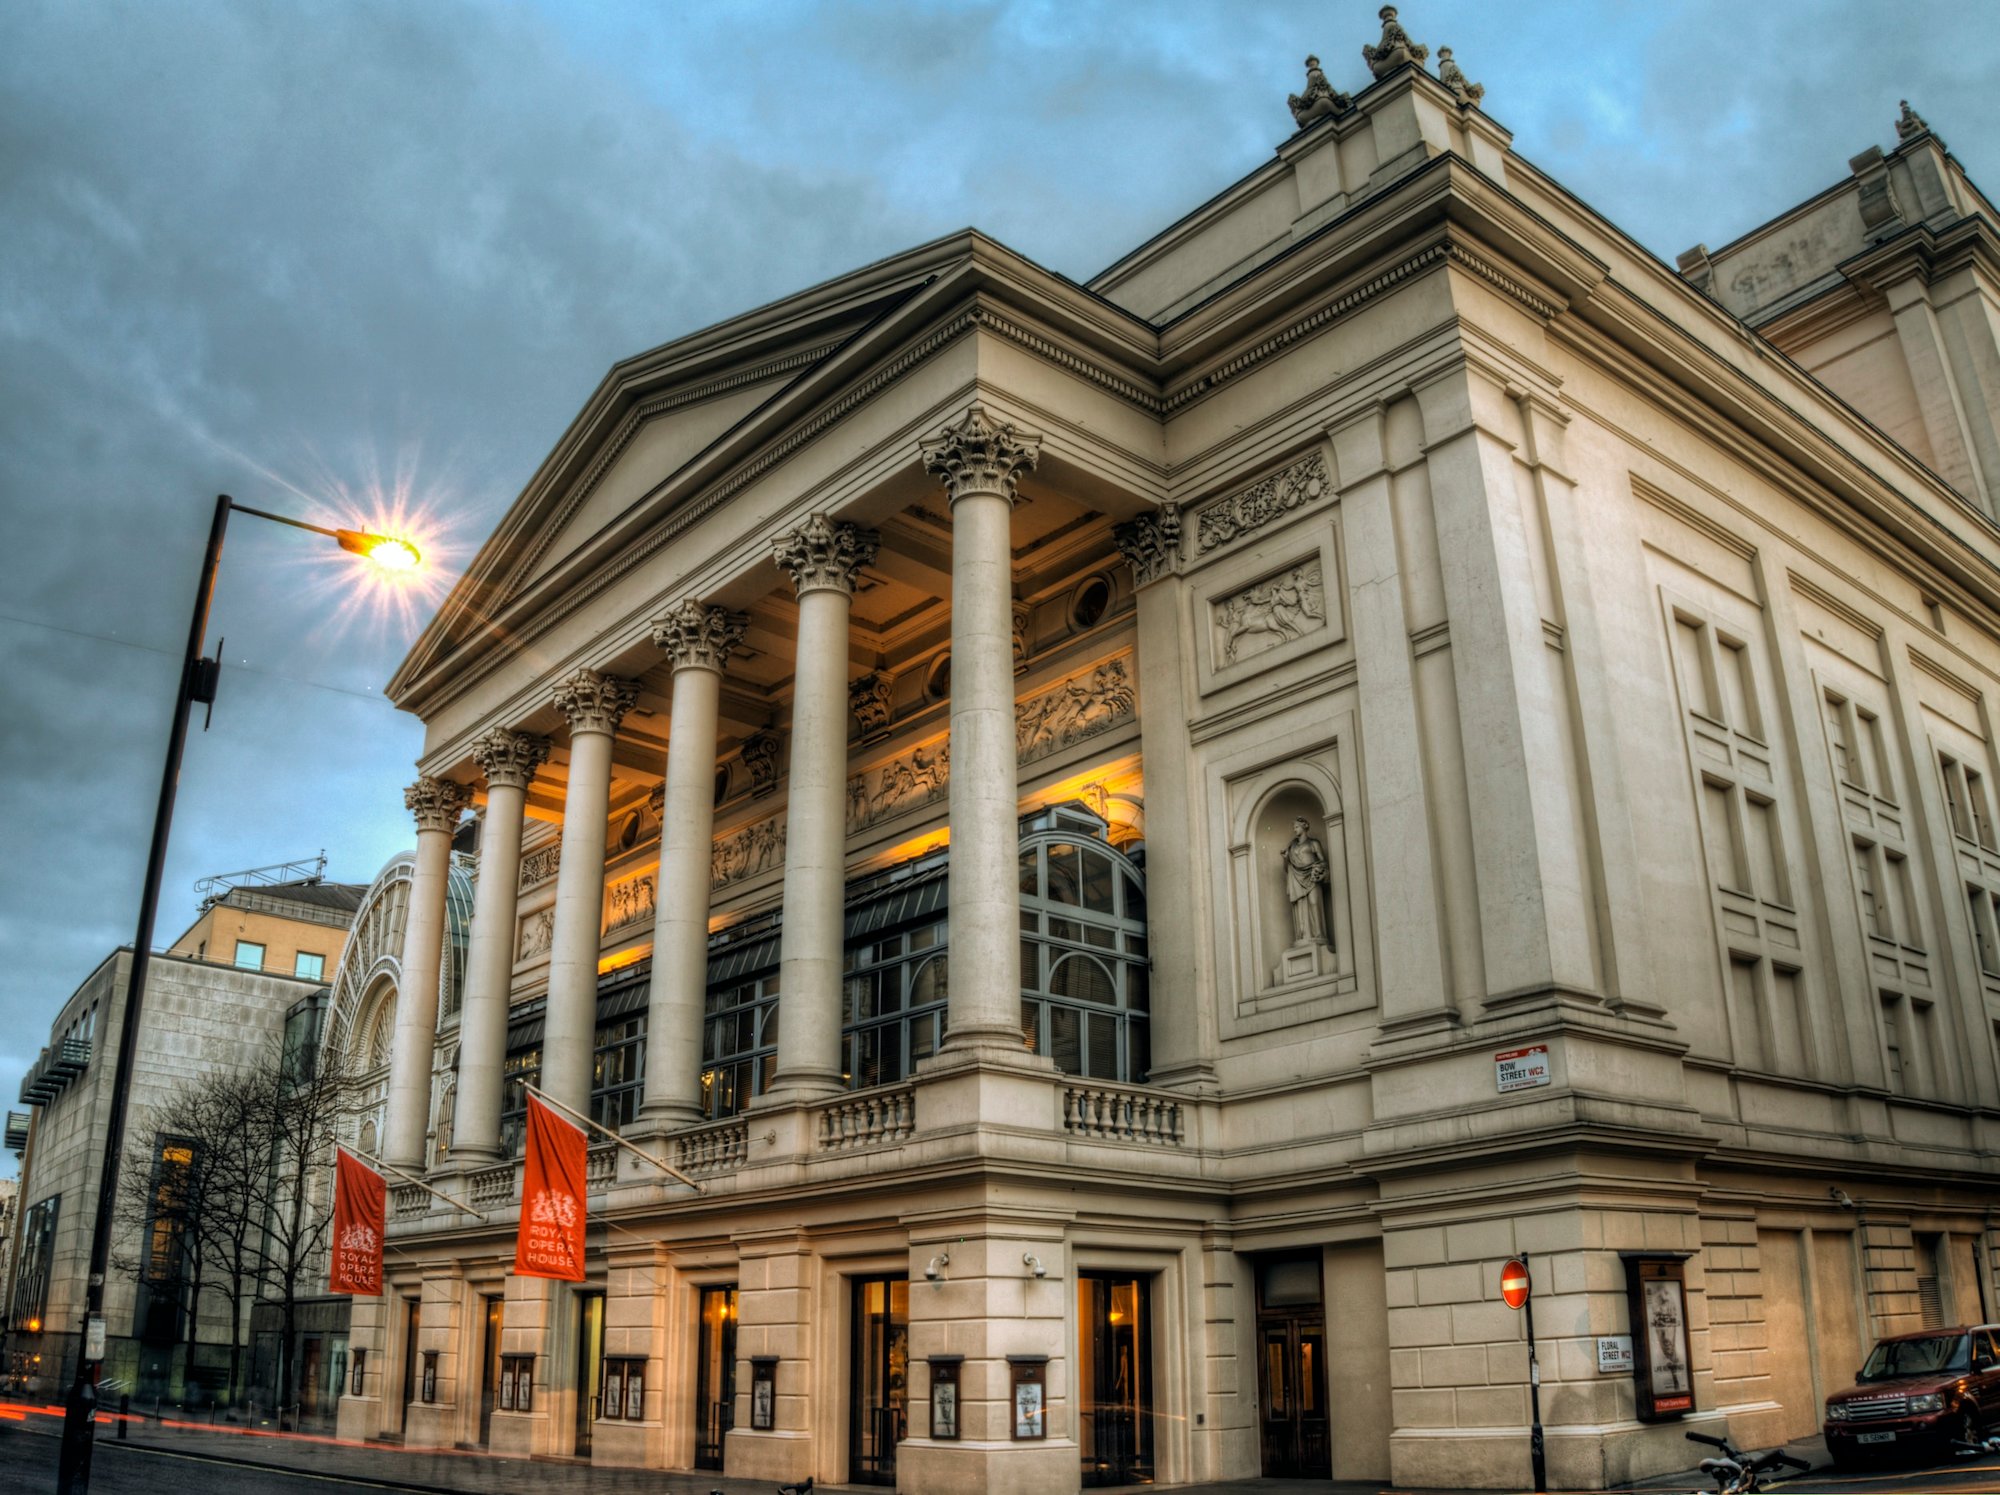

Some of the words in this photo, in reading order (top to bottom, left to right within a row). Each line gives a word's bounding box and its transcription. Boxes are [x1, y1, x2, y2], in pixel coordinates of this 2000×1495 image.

[1500, 1062, 1515, 1072] BOW
[1501, 1070, 1526, 1081] STREET
[1528, 1066, 1544, 1076] WC2
[530, 1225, 574, 1241] ROYAL
[528, 1239, 575, 1254] OPERA
[340, 1251, 375, 1264] ROYAL
[527, 1253, 574, 1267] HOUSE
[340, 1262, 375, 1274] OPERA
[340, 1273, 374, 1285] HOUSE
[1602, 1341, 1619, 1350] FLORAL
[1603, 1351, 1619, 1360] STREET
[1621, 1351, 1631, 1359] WC2
